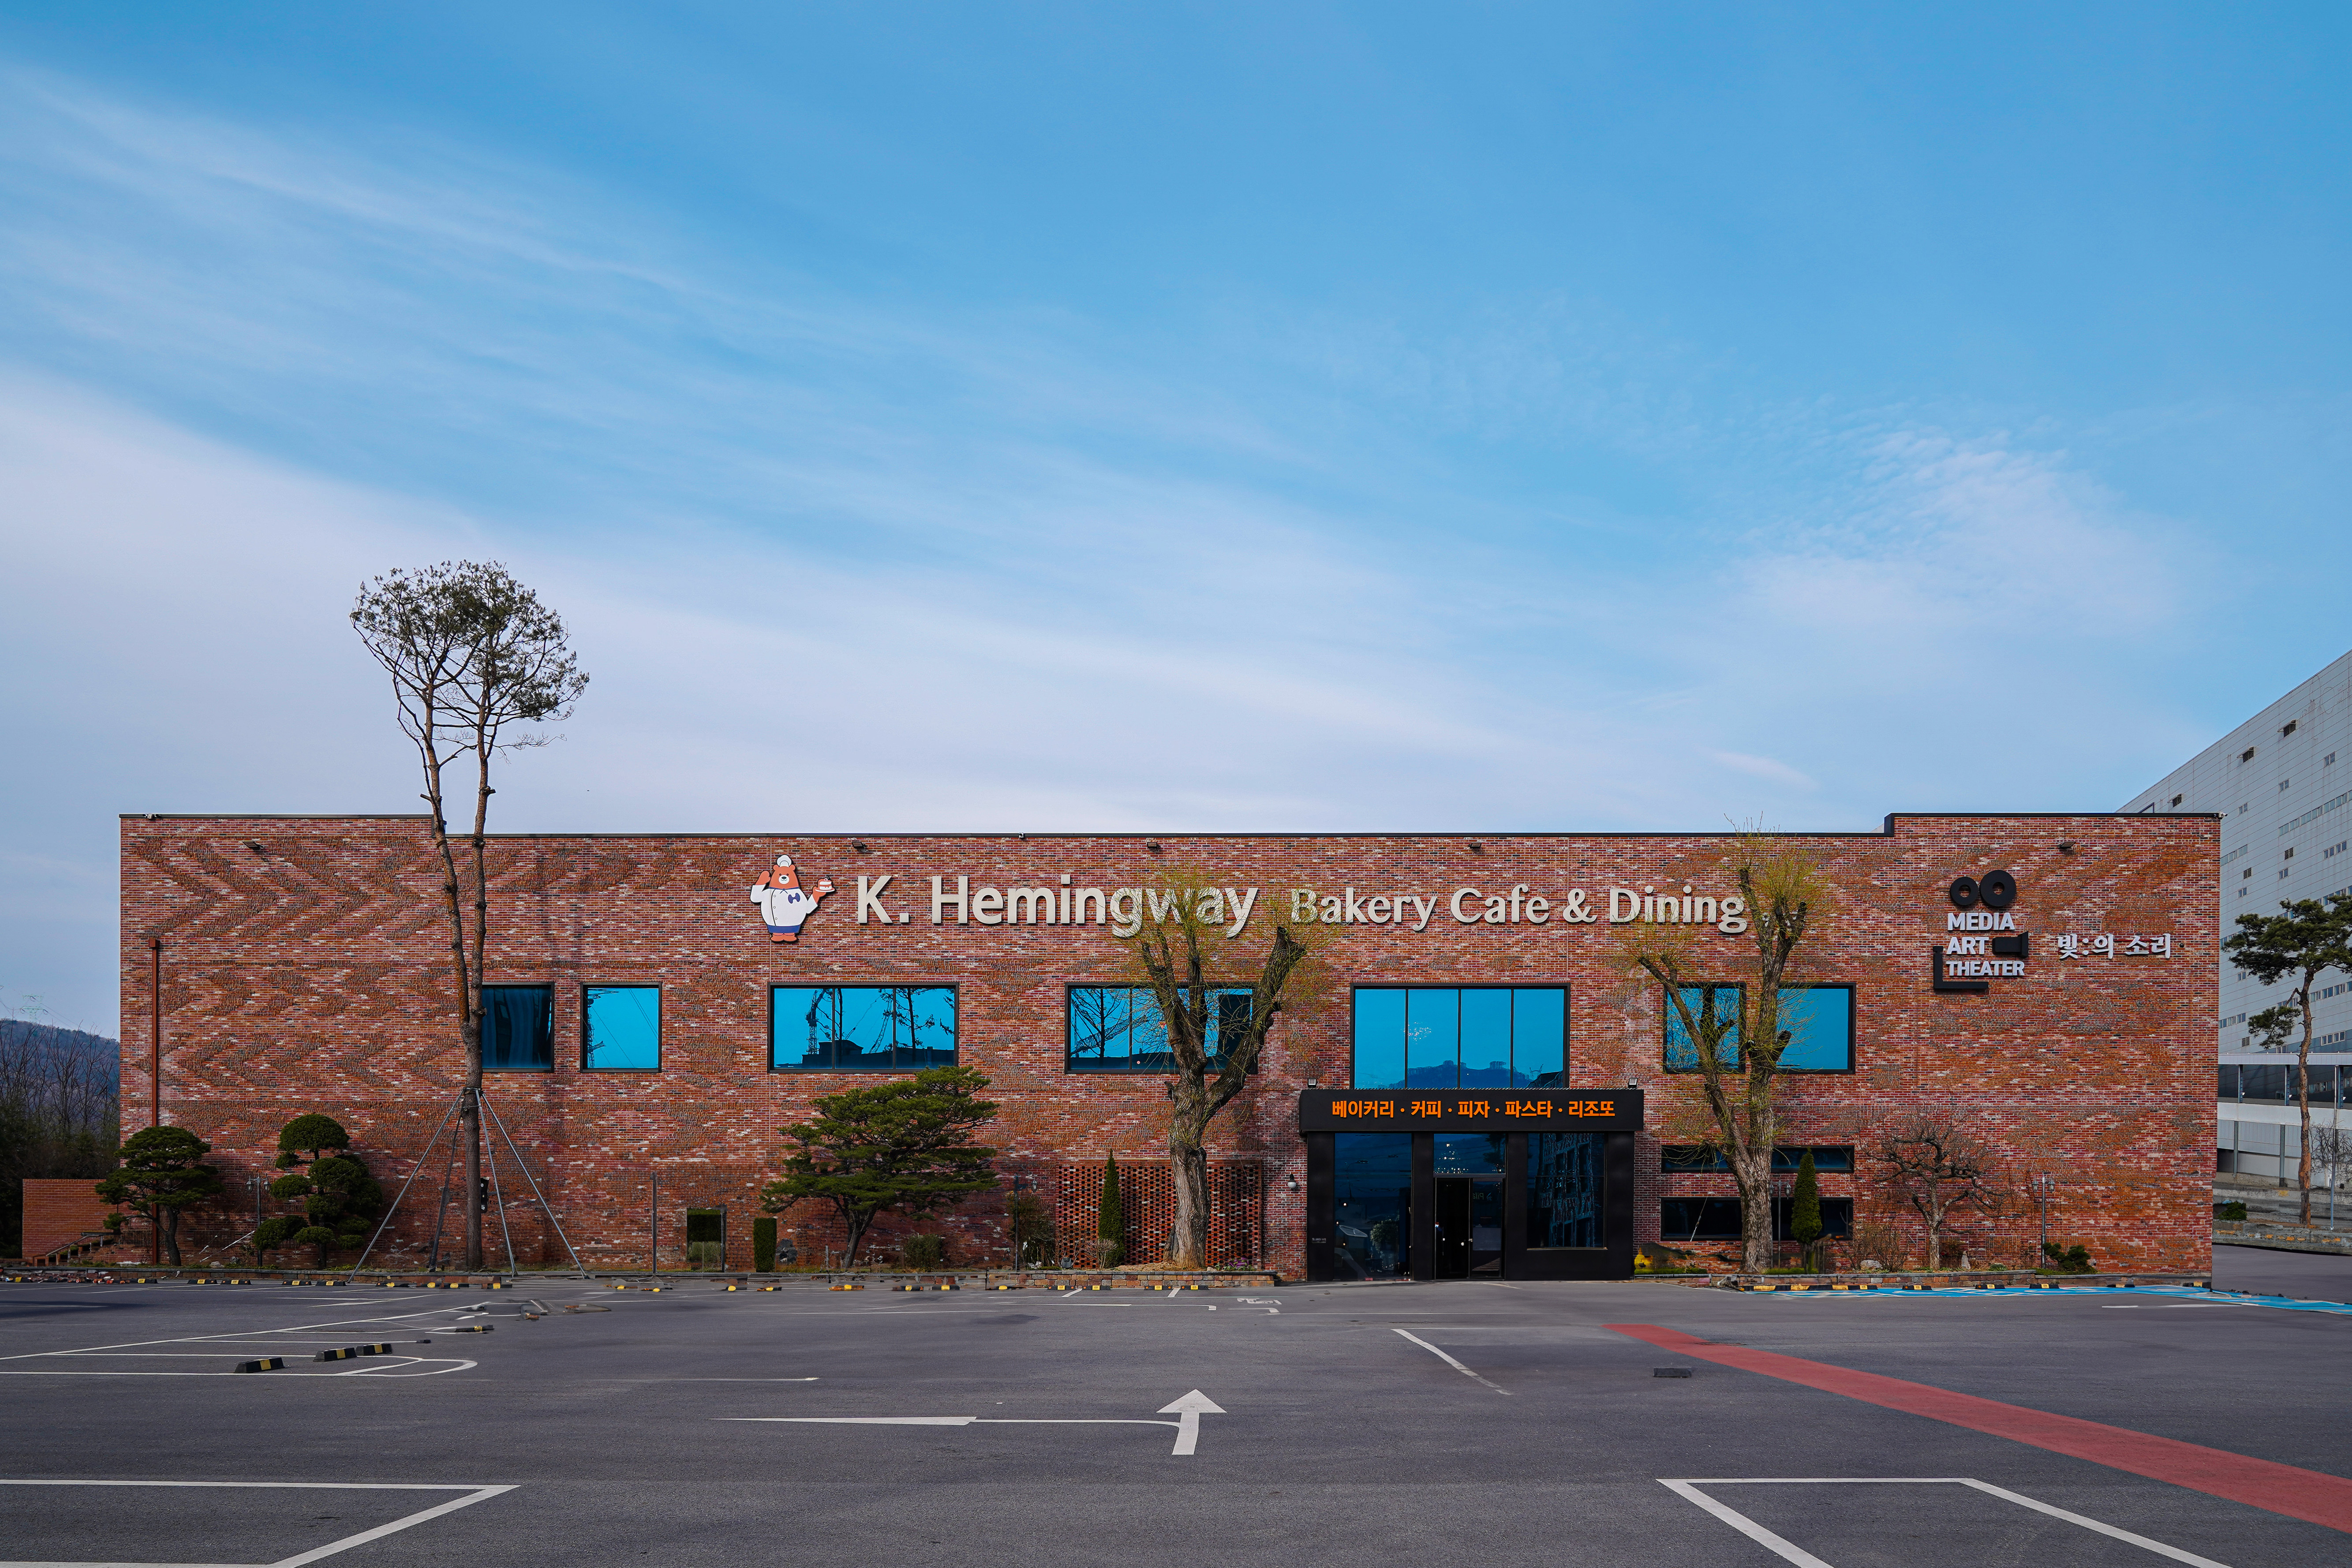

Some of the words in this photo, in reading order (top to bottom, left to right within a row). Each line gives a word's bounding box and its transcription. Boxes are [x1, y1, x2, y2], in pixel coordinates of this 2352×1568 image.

[857, 875, 909, 924] K.
[933, 874, 1259, 938] Hemingway
[1291, 887, 1437, 931] Bakery
[1451, 884, 1550, 923] Cafe
[1563, 888, 1597, 923] &
[1610, 885, 1748, 933] Dining
[1947, 912, 2015, 931] MEDIA
[1946, 936, 1989, 955] ART
[2124, 932, 2171, 960] 소리
[1945, 961, 2025, 977] THEATER
[1332, 1100, 1394, 1119] 베이커리
[1410, 1100, 1441, 1119] 커피
[1458, 1100, 1490, 1119] 피자
[1504, 1100, 1553, 1119] 파스타
[1568, 1100, 1615, 1119] 리조또
